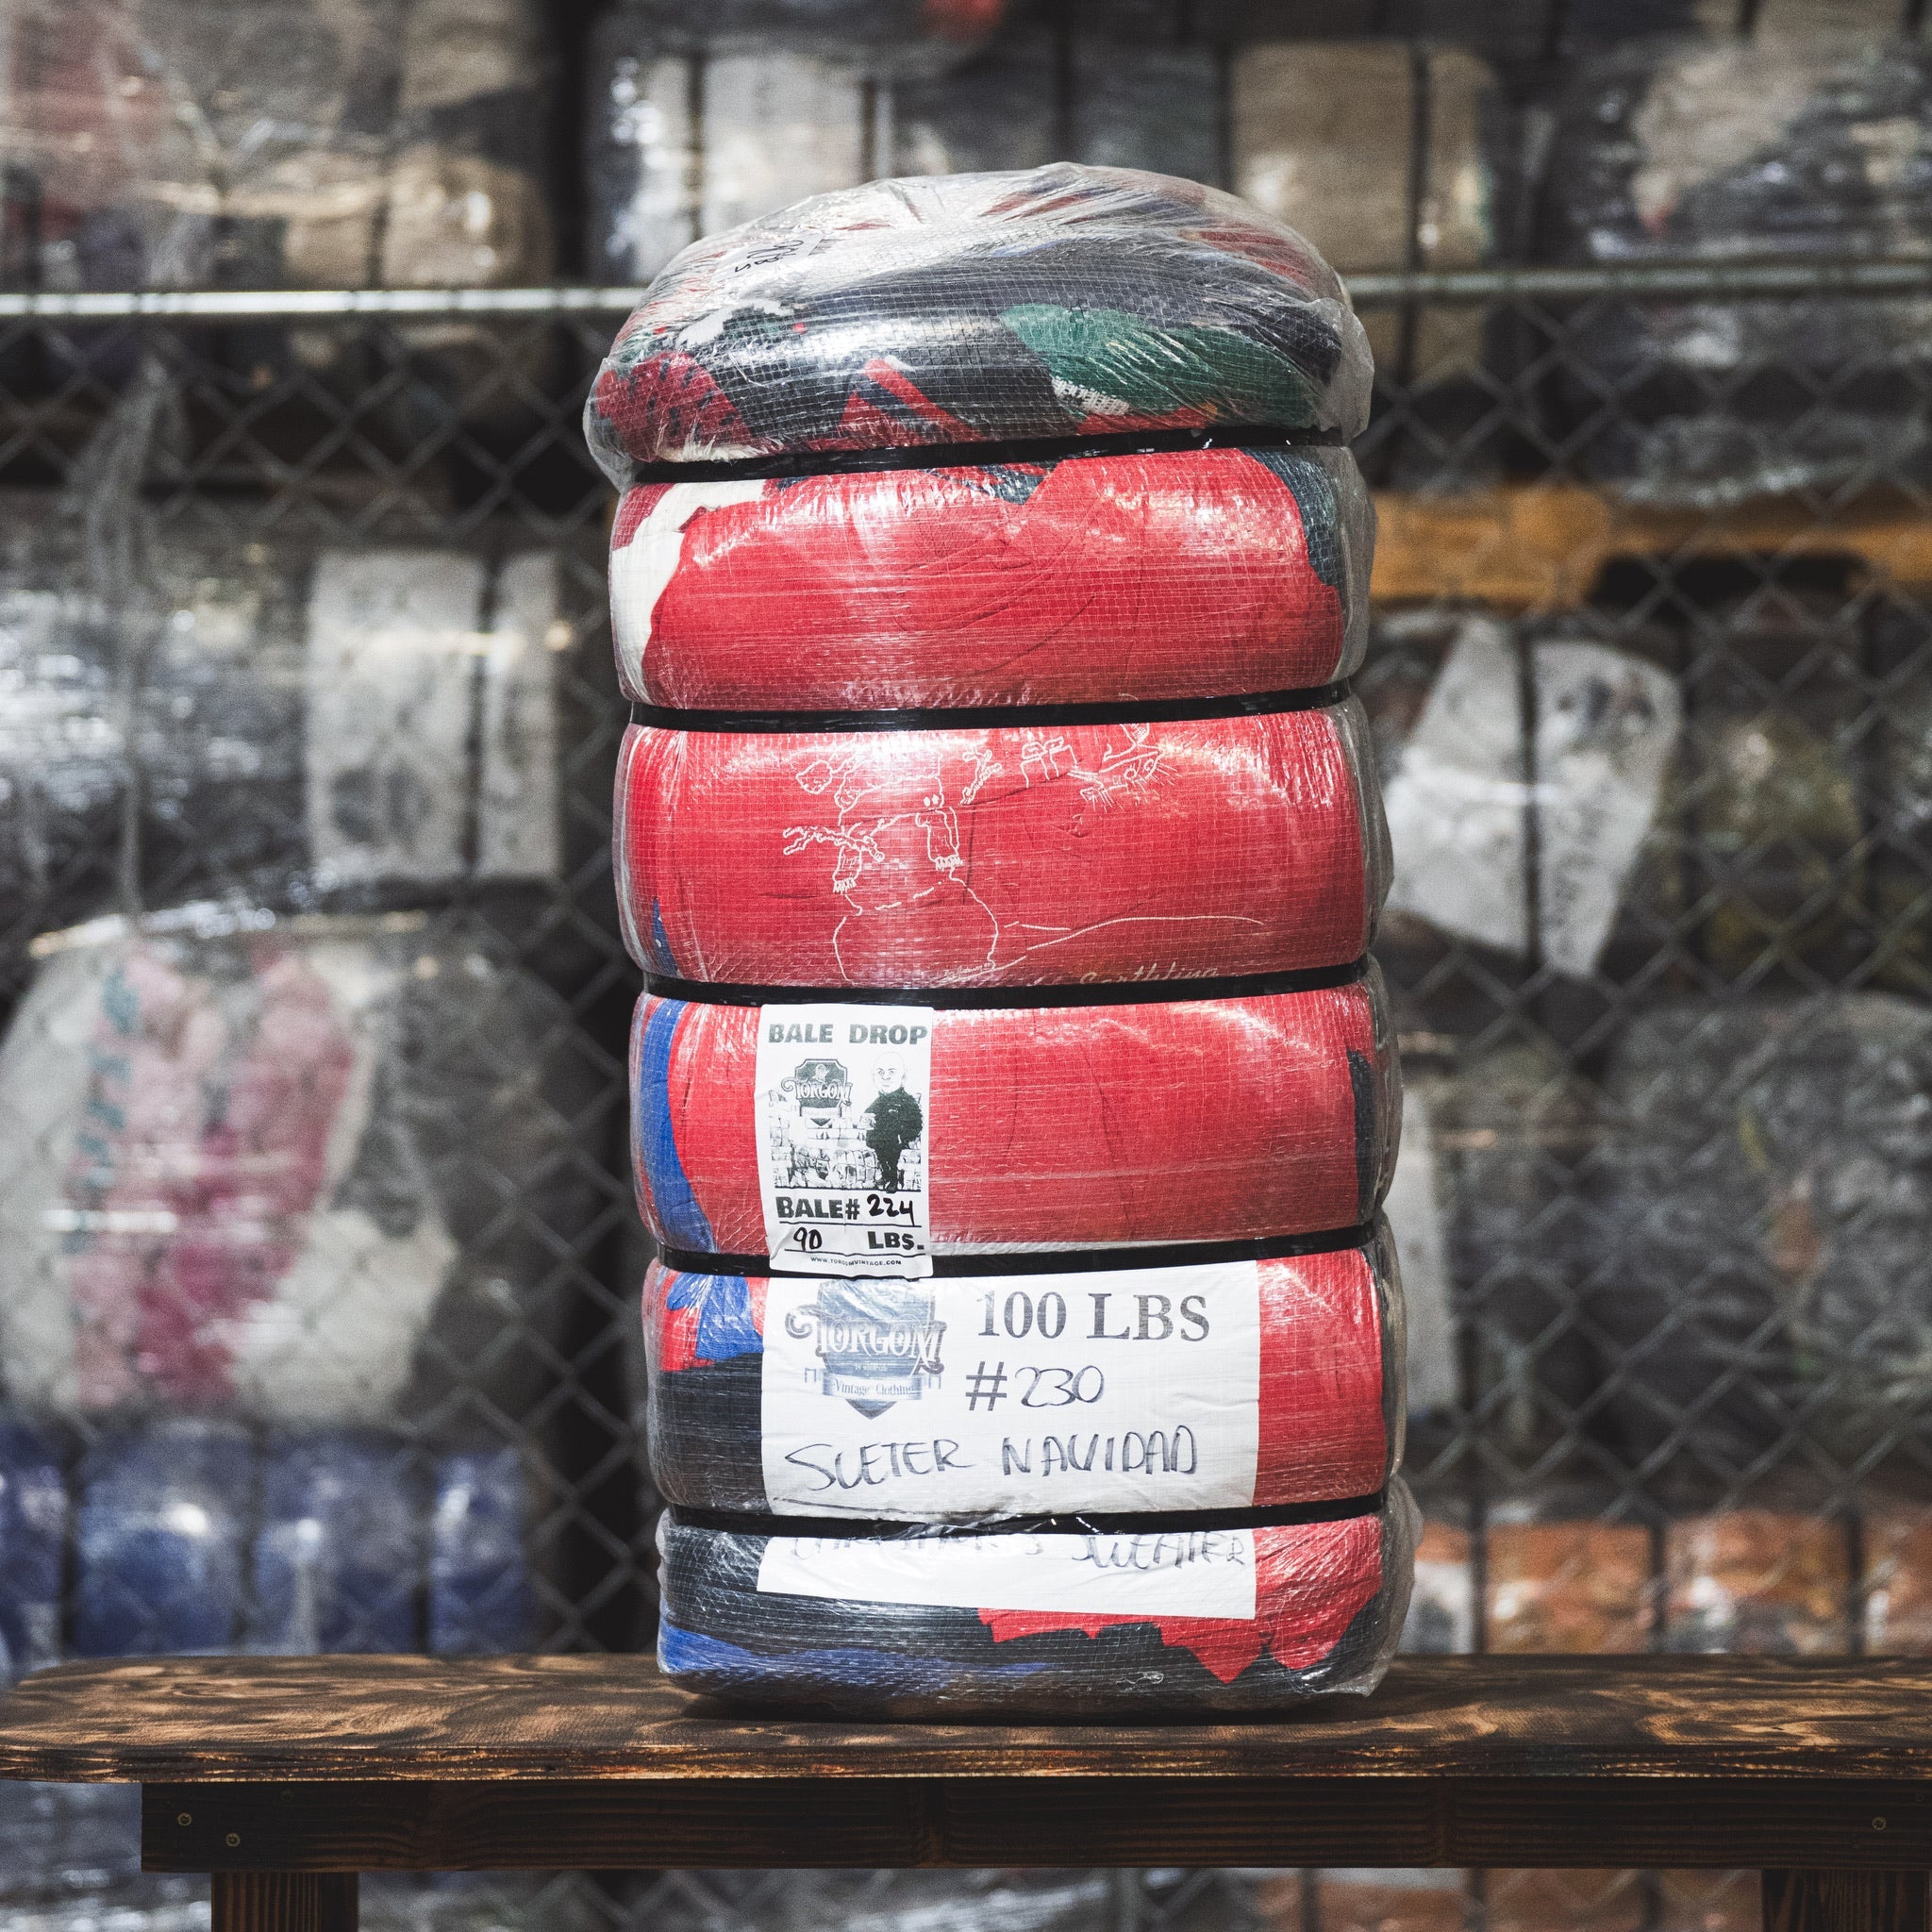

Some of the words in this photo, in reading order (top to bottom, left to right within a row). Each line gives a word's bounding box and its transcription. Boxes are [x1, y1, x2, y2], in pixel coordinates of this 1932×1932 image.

[769, 1024, 834, 1043] BALE
[849, 1024, 928, 1045] DROP
[775, 1196, 859, 1220] BALE#
[866, 1193, 915, 1225] 224
[792, 1227, 823, 1251] 90
[867, 1231, 925, 1250] LBS.
[976, 1290, 1068, 1338] 100
[1087, 1292, 1210, 1341] LBS
[785, 1304, 947, 1377] TORGOM
[834, 1377, 870, 1395] Vintage
[1002, 1425, 1197, 1476] NAVIDAD
